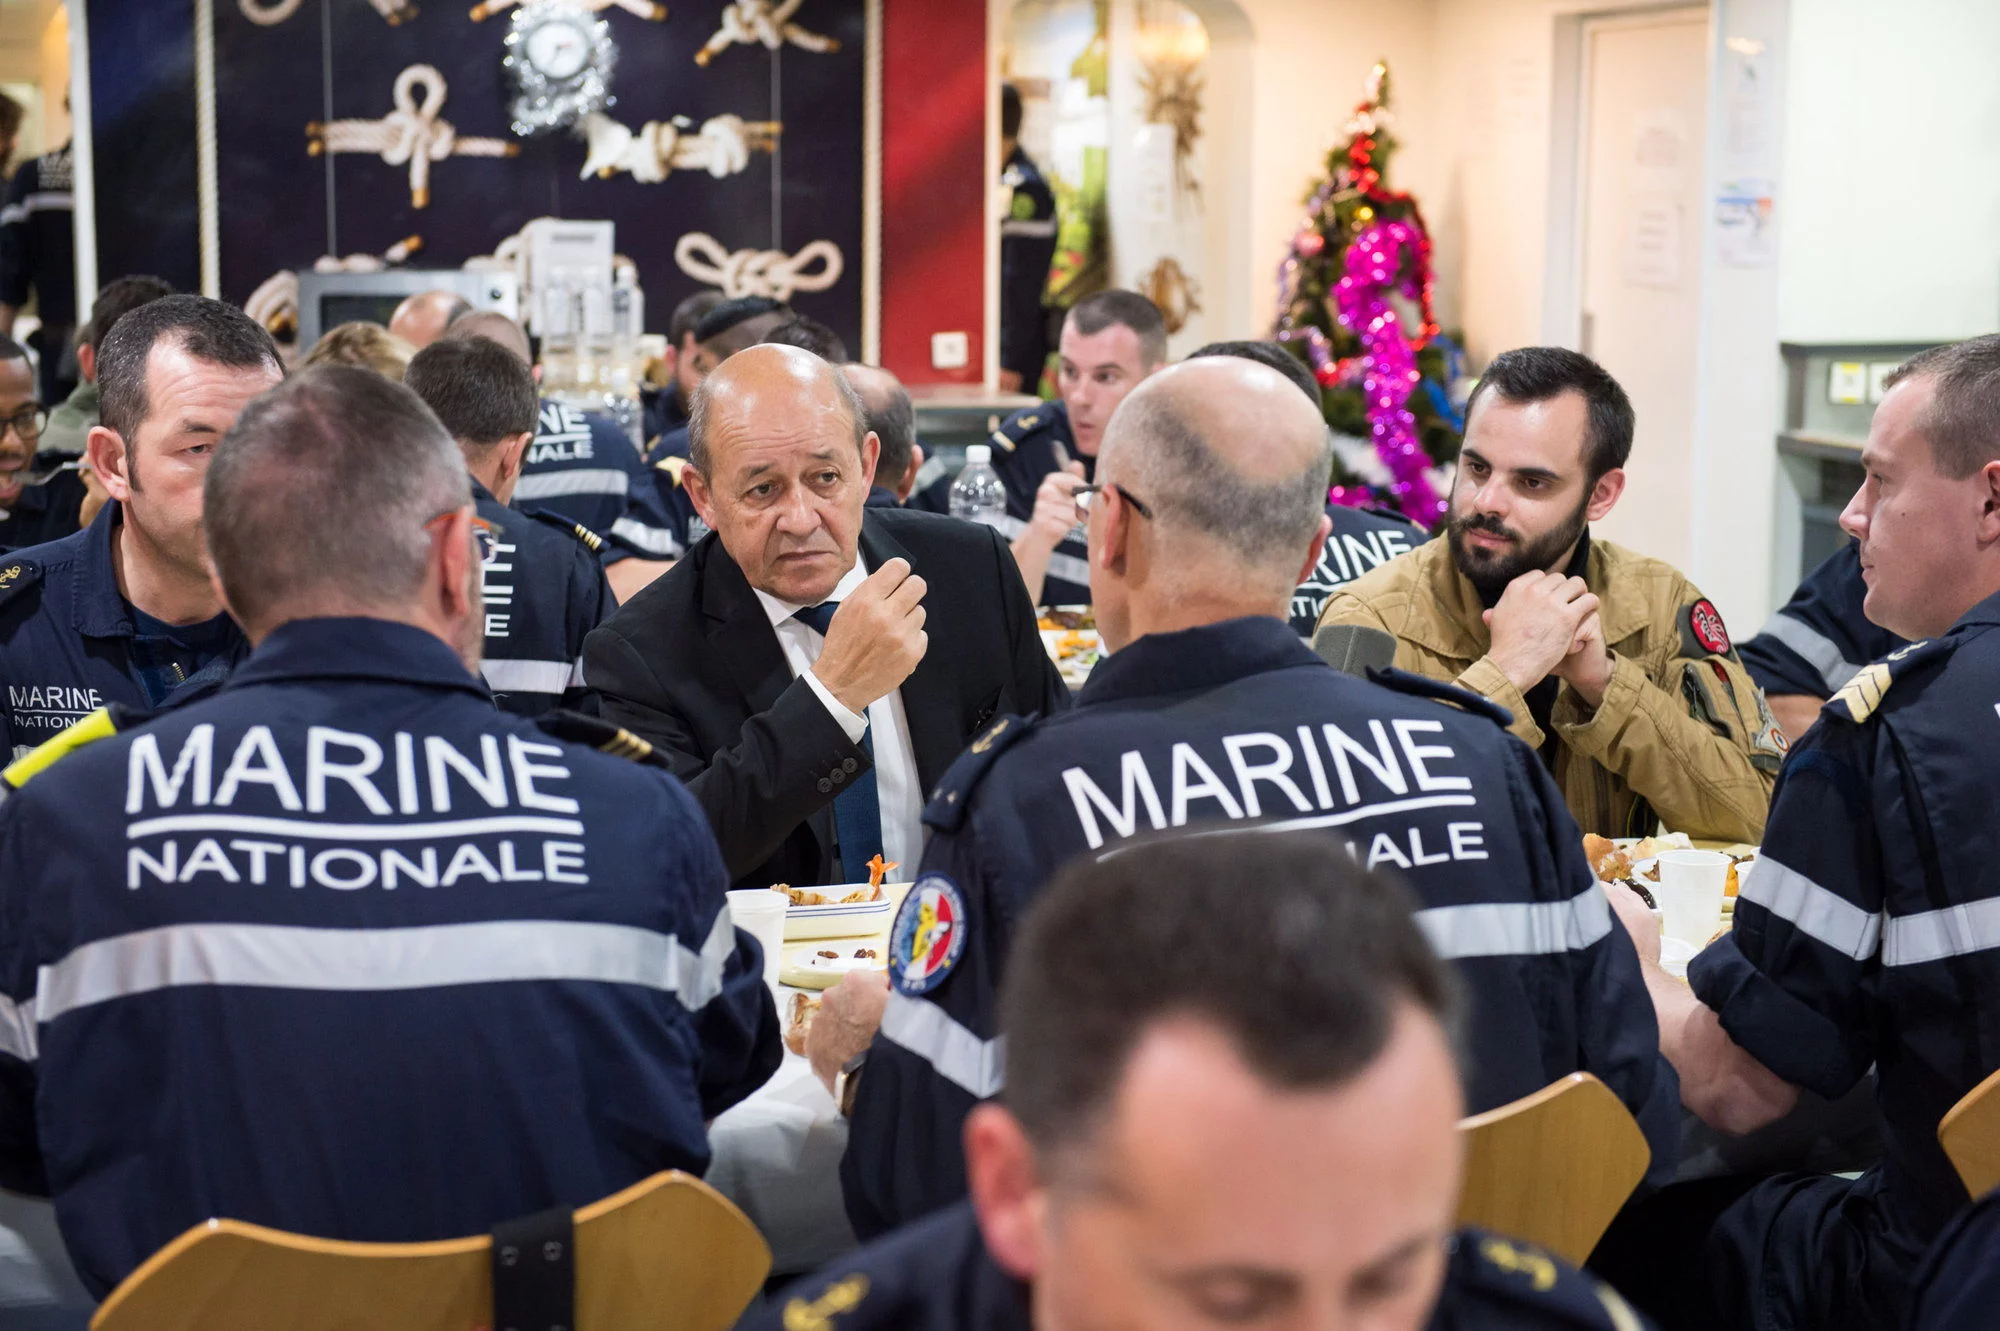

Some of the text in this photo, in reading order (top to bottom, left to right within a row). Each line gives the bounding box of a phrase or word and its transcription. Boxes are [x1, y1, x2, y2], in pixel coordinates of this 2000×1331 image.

[1308, 530, 1412, 583] RINE
[9, 685, 103, 710] MARINE
[14, 714, 82, 729] NATION
[125, 723, 580, 815] MARINE
[1061, 718, 1474, 850] MARINE
[126, 838, 590, 890] NATIONALE
